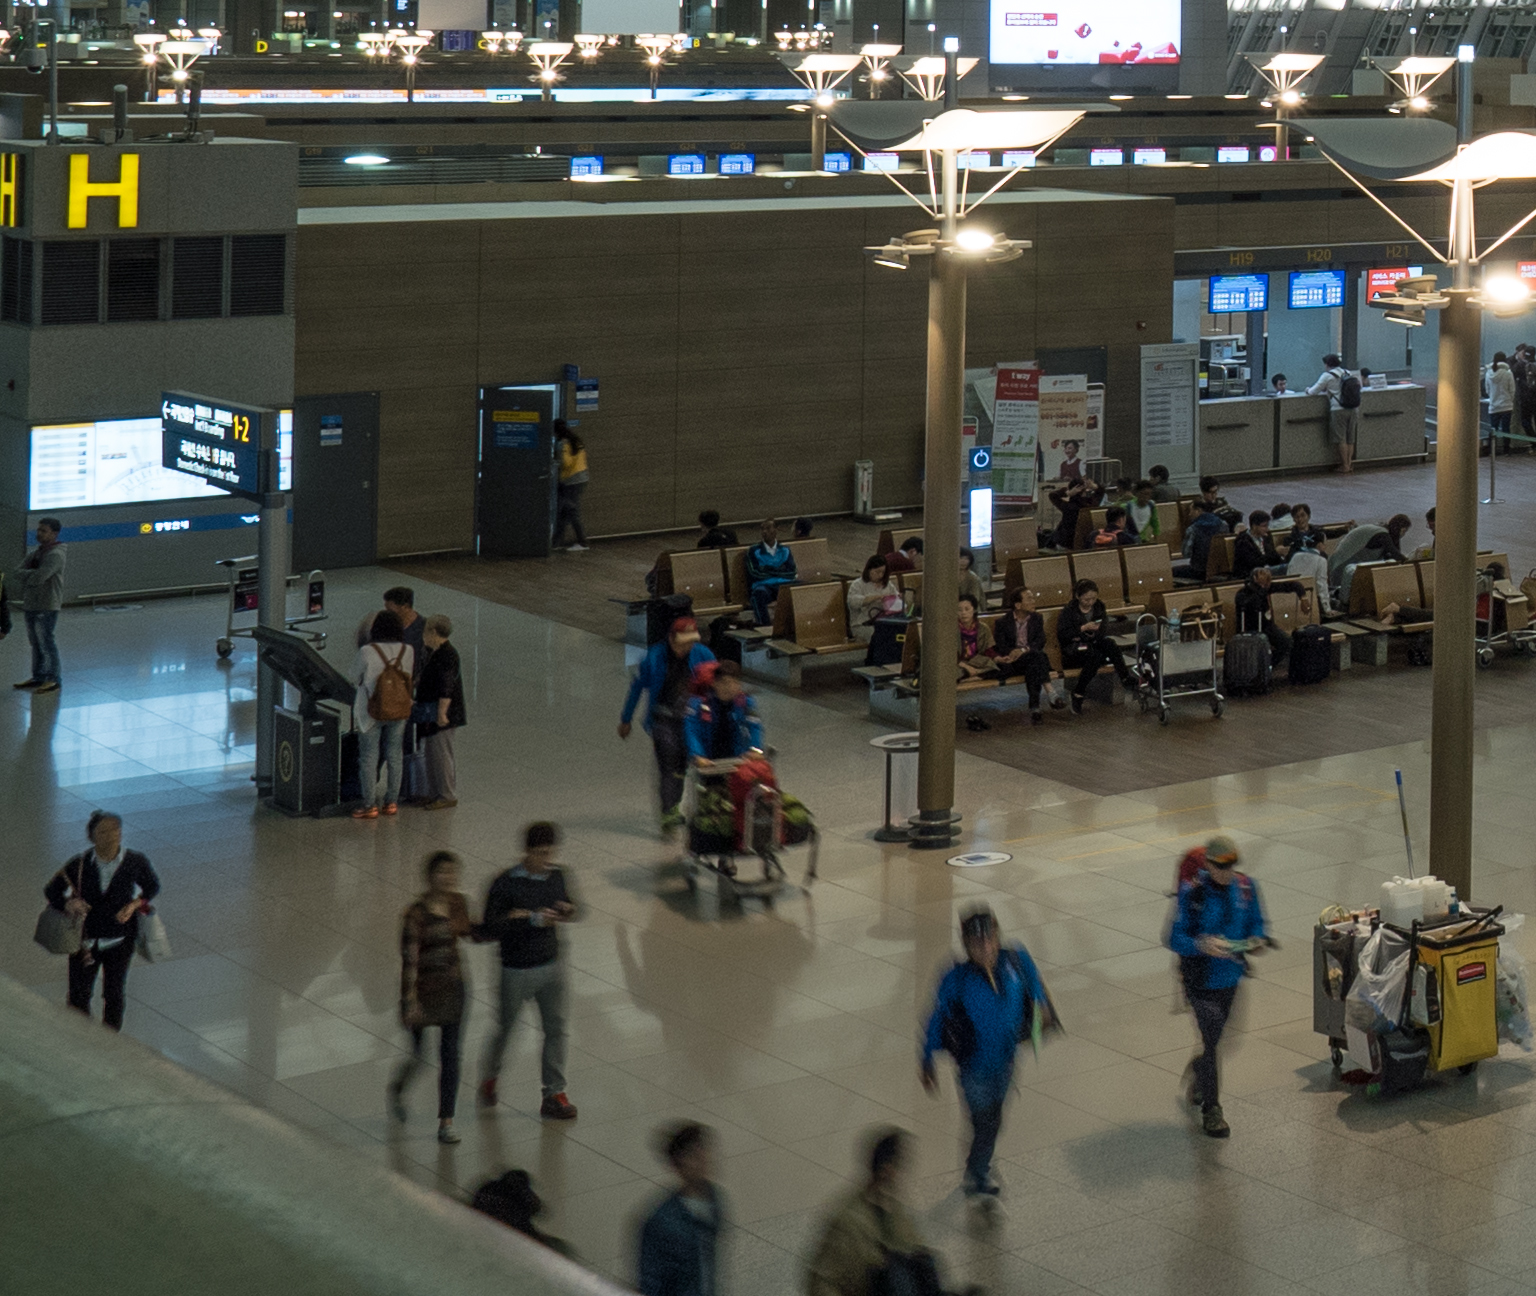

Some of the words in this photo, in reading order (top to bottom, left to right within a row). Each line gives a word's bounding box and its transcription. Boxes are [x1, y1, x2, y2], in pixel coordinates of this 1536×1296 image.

[255, 40, 269, 54] D
[68, 154, 140, 229] H
[1306, 249, 1332, 262] H20
[1386, 245, 1409, 258] H21
[1229, 252, 1255, 265] H19
[233, 414, 250, 443] 1-2
